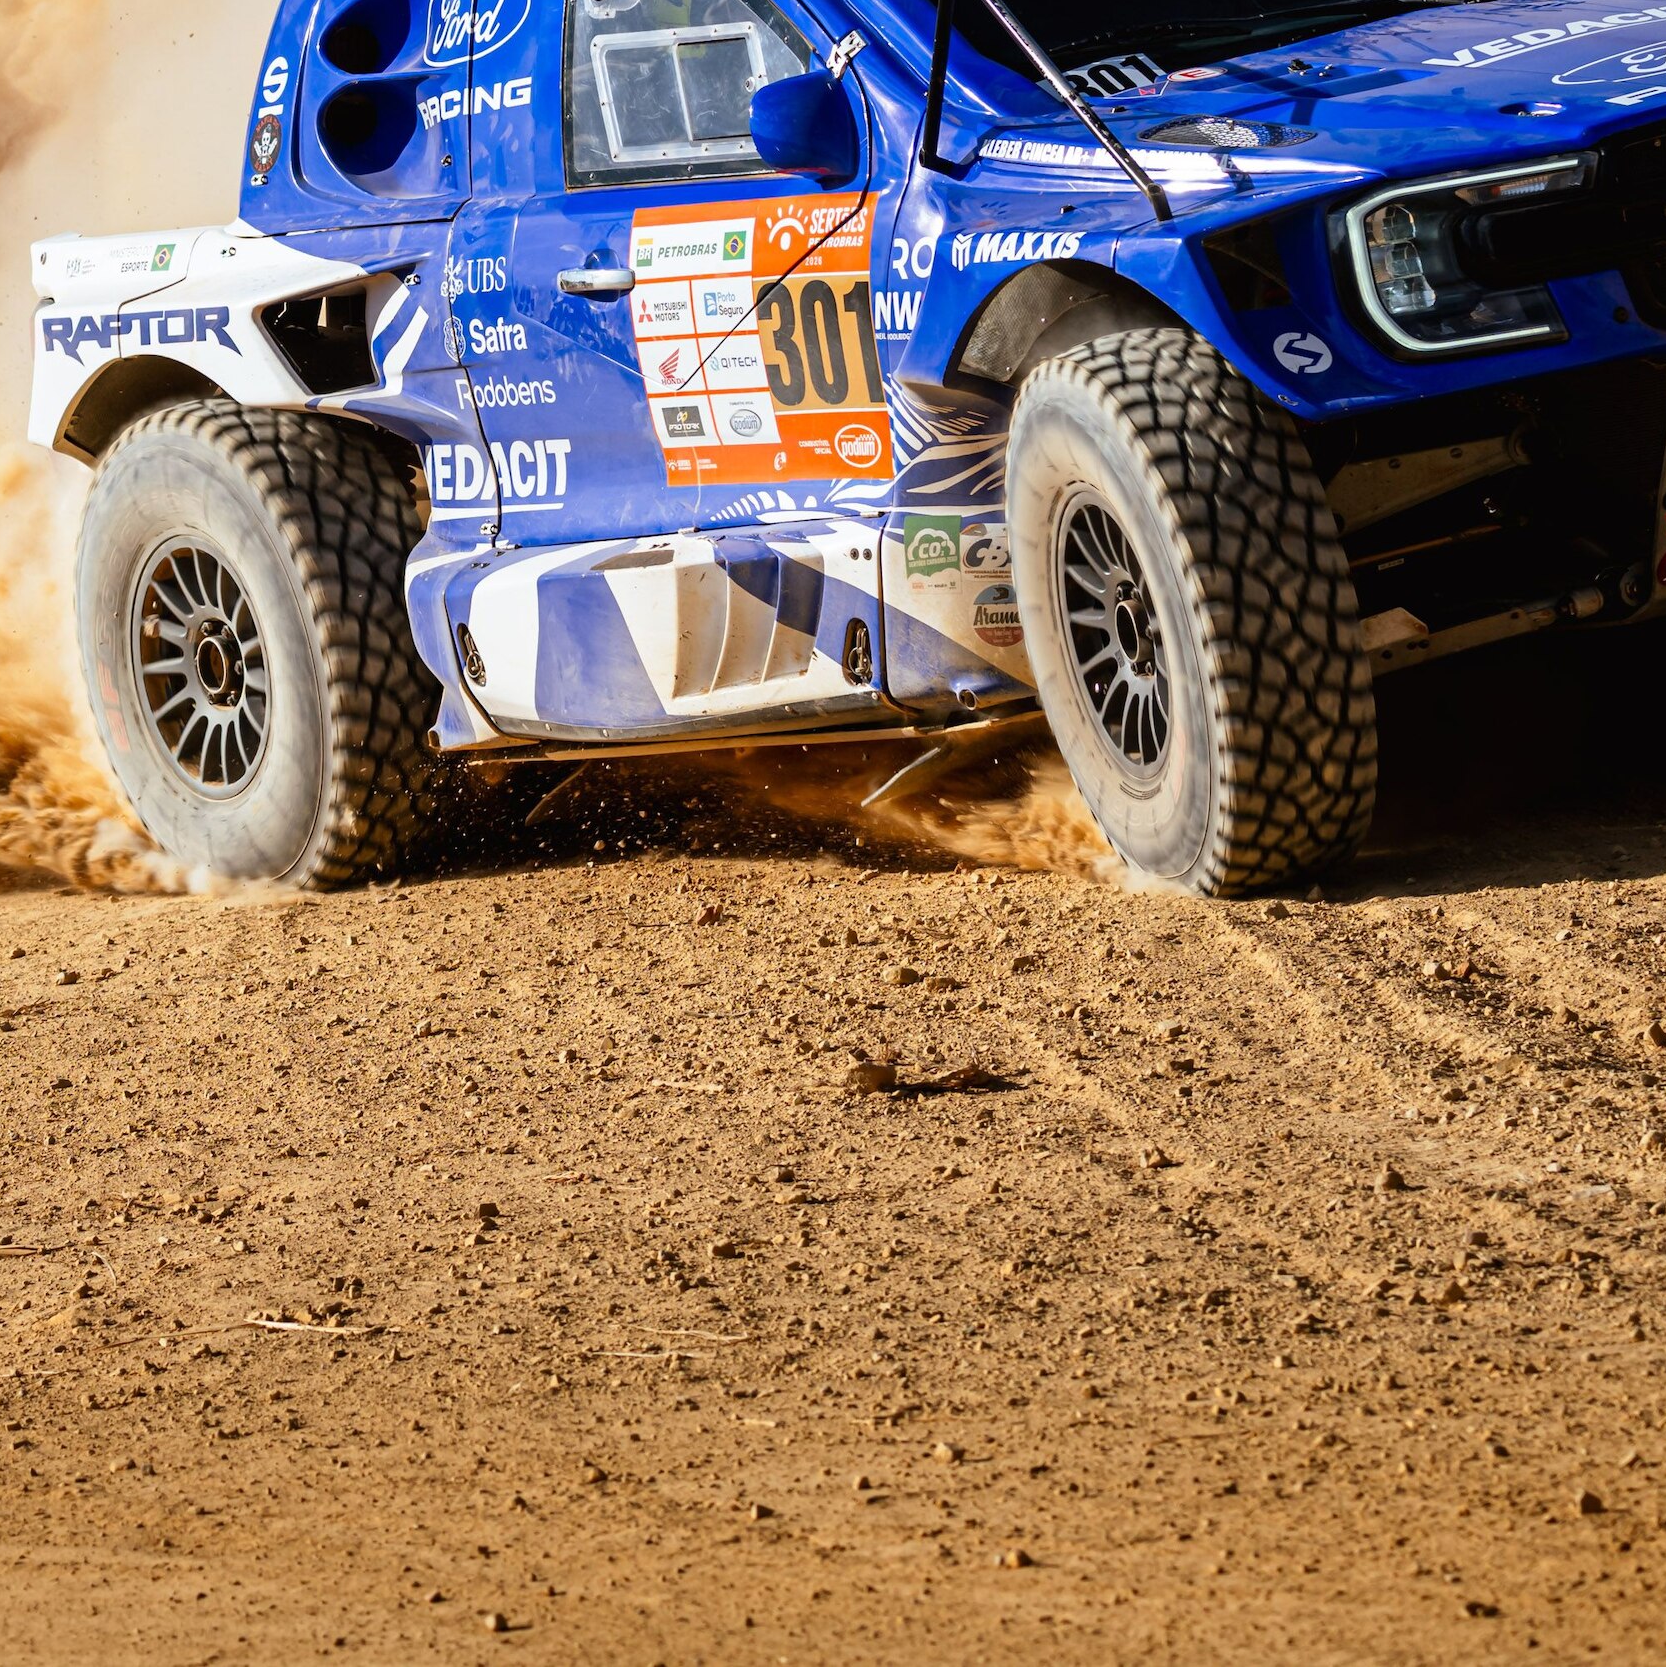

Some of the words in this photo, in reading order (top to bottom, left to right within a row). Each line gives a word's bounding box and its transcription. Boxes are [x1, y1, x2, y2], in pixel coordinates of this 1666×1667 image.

[417, 76, 532, 130] RACING
[809, 207, 868, 234] SERTÕES
[657, 242, 718, 259] PETROBRAS
[808, 235, 864, 248] PETROBRAS
[973, 232, 1088, 263] MAXXIS
[120, 260, 149, 273] ESPORTE
[467, 256, 507, 294] UBS
[653, 300, 688, 312] MITSUBISHI
[717, 292, 736, 302] Porto
[654, 311, 681, 322] MOTORS
[718, 305, 744, 318] Seguro
[42, 305, 244, 365] RAPTOR
[469, 316, 528, 355] Safra
[757, 279, 885, 406] 301
[455, 375, 557, 410] Rodobens
[841, 436, 876, 457] podium
